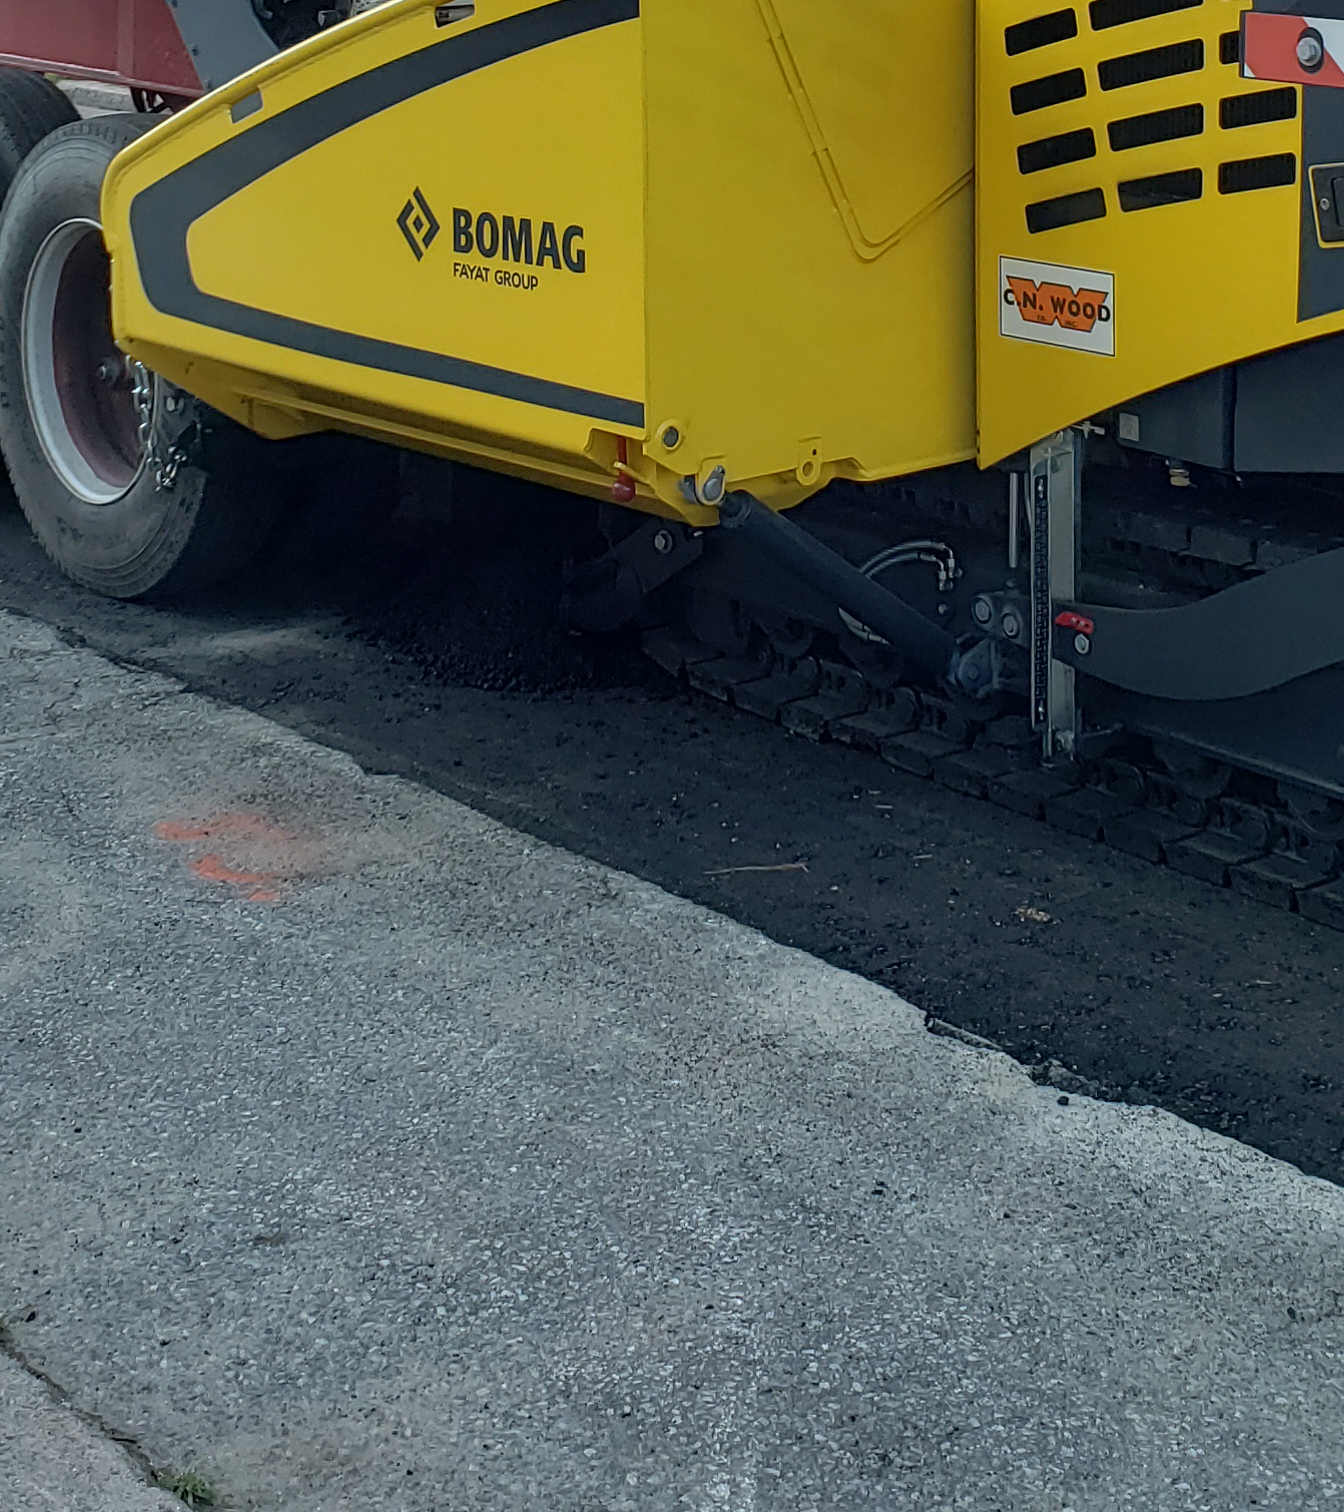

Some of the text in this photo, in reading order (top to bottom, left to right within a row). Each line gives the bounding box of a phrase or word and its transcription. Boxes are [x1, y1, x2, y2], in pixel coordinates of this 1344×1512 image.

[452, 207, 586, 274] BOMAG
[453, 261, 539, 291] FAYAT GROUP
[1049, 293, 1111, 322] WOOD
